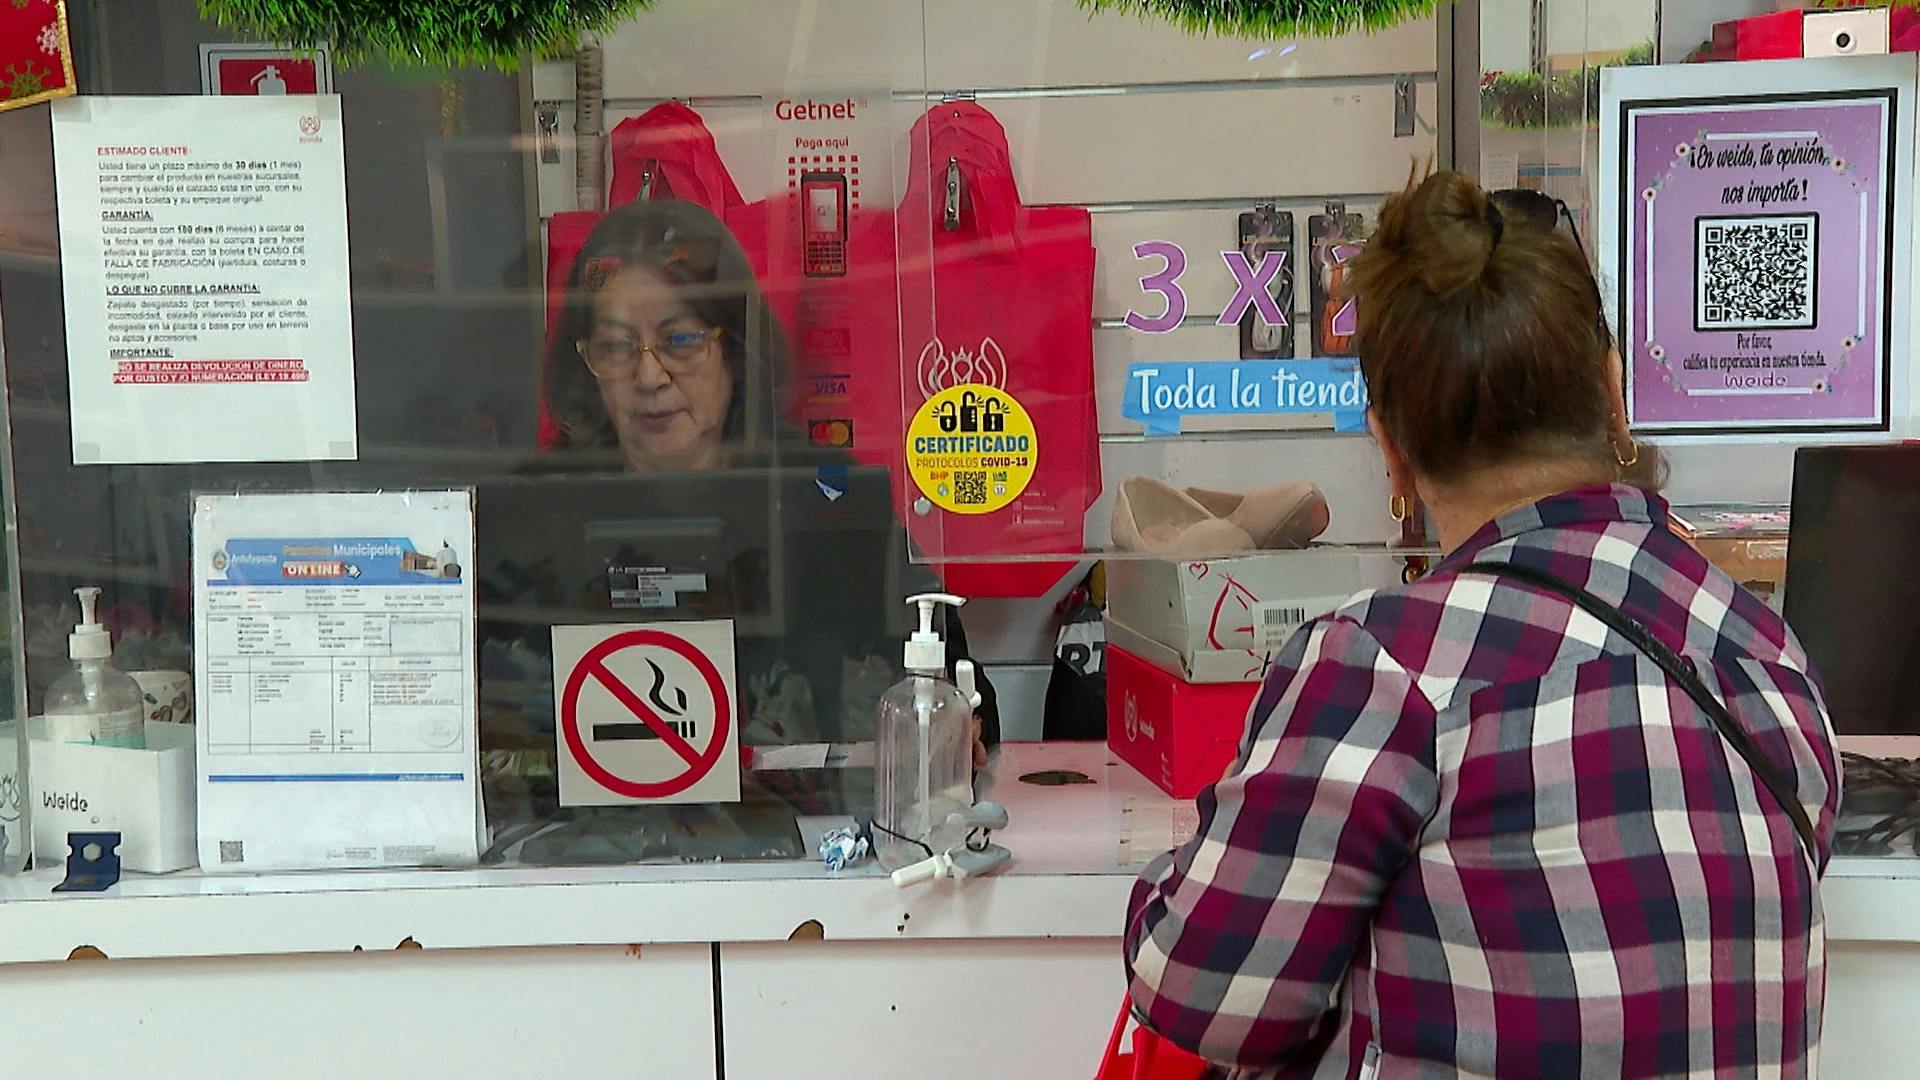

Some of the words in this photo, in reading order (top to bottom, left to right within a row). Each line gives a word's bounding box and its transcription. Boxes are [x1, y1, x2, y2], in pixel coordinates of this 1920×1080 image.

[776, 98, 855, 120] Getnet
[98, 147, 147, 155] ESTIMADO
[1759, 142, 1774, 166] tu
[99, 162, 123, 170] Usted
[126, 162, 146, 170] tiene
[163, 162, 185, 171] plazo
[223, 160, 233, 169] de
[100, 174, 119, 183] para
[120, 173, 154, 182] cambiar
[157, 173, 165, 181] el
[167, 173, 203, 183] producto
[217, 172, 254, 180] nuestras
[100, 185, 134, 195] siempre
[136, 187, 142, 195] y
[143, 185, 174, 193] cuando
[176, 184, 184, 192] el
[186, 184, 218, 193] calzado
[241, 184, 253, 192] sin
[274, 184, 290, 192] con
[292, 184, 303, 192] su
[1721, 184, 1744, 204] nos
[101, 196, 143, 205] respectiva
[145, 196, 171, 204] boleta
[172, 197, 178, 206] y
[180, 196, 191, 204] su
[193, 195, 231, 205] empaque
[103, 225, 128, 234] Usted
[129, 225, 158, 234] cuenta
[160, 226, 175, 234] con
[226, 224, 257, 233] meses)
[266, 224, 291, 232] contar
[293, 223, 304, 232] de
[103, 237, 111, 246] la
[115, 236, 139, 246] fecha
[210, 236, 220, 244] su
[223, 236, 255, 245] compra
[259, 236, 278, 245] para
[281, 235, 305, 243] hacer
[103, 248, 137, 257] efectiva
[139, 248, 149, 256] su
[191, 248, 207, 256] con
[208, 247, 217, 255] la
[219, 247, 245, 256] boleta
[247, 246, 260, 255] EN
[263, 246, 290, 255] CASO
[292, 245, 305, 254] DE
[105, 258, 133, 268] FALLA
[136, 258, 149, 268] DE
[262, 258, 298, 266] costuras
[300, 258, 306, 266] o
[106, 285, 119, 296] LO
[121, 285, 141, 296] QUE
[143, 285, 158, 296] NO
[160, 285, 193, 295] CUBRE
[194, 285, 208, 295] LA
[1124, 240, 1188, 333] 3
[140, 300, 188, 310] desgastado
[296, 299, 308, 307] de
[166, 311, 198, 320] calzado
[201, 311, 247, 319] intervenido
[250, 310, 264, 319] por
[267, 310, 276, 318] el
[108, 322, 146, 332] desgaste
[148, 322, 160, 331] en
[162, 322, 170, 331] la
[172, 322, 198, 332] planta
[208, 322, 229, 330] base
[231, 322, 246, 331] por
[248, 322, 264, 330] uso
[266, 321, 277, 329] en
[279, 320, 309, 329] terreno
[145, 335, 152, 343] y
[118, 361, 132, 371] NO
[149, 361, 189, 371] REALIZA
[135, 373, 169, 382] GUSTO
[816, 382, 846, 394] VISA
[1132, 367, 1216, 414] Toda
[1231, 367, 1261, 408] la
[1272, 367, 1370, 408] tiend
[915, 436, 1029, 453] CERTIFICADO
[916, 457, 978, 468] PROTOCOLOS
[981, 457, 1028, 467] COVID-19
[333, 543, 401, 560] Municipales
